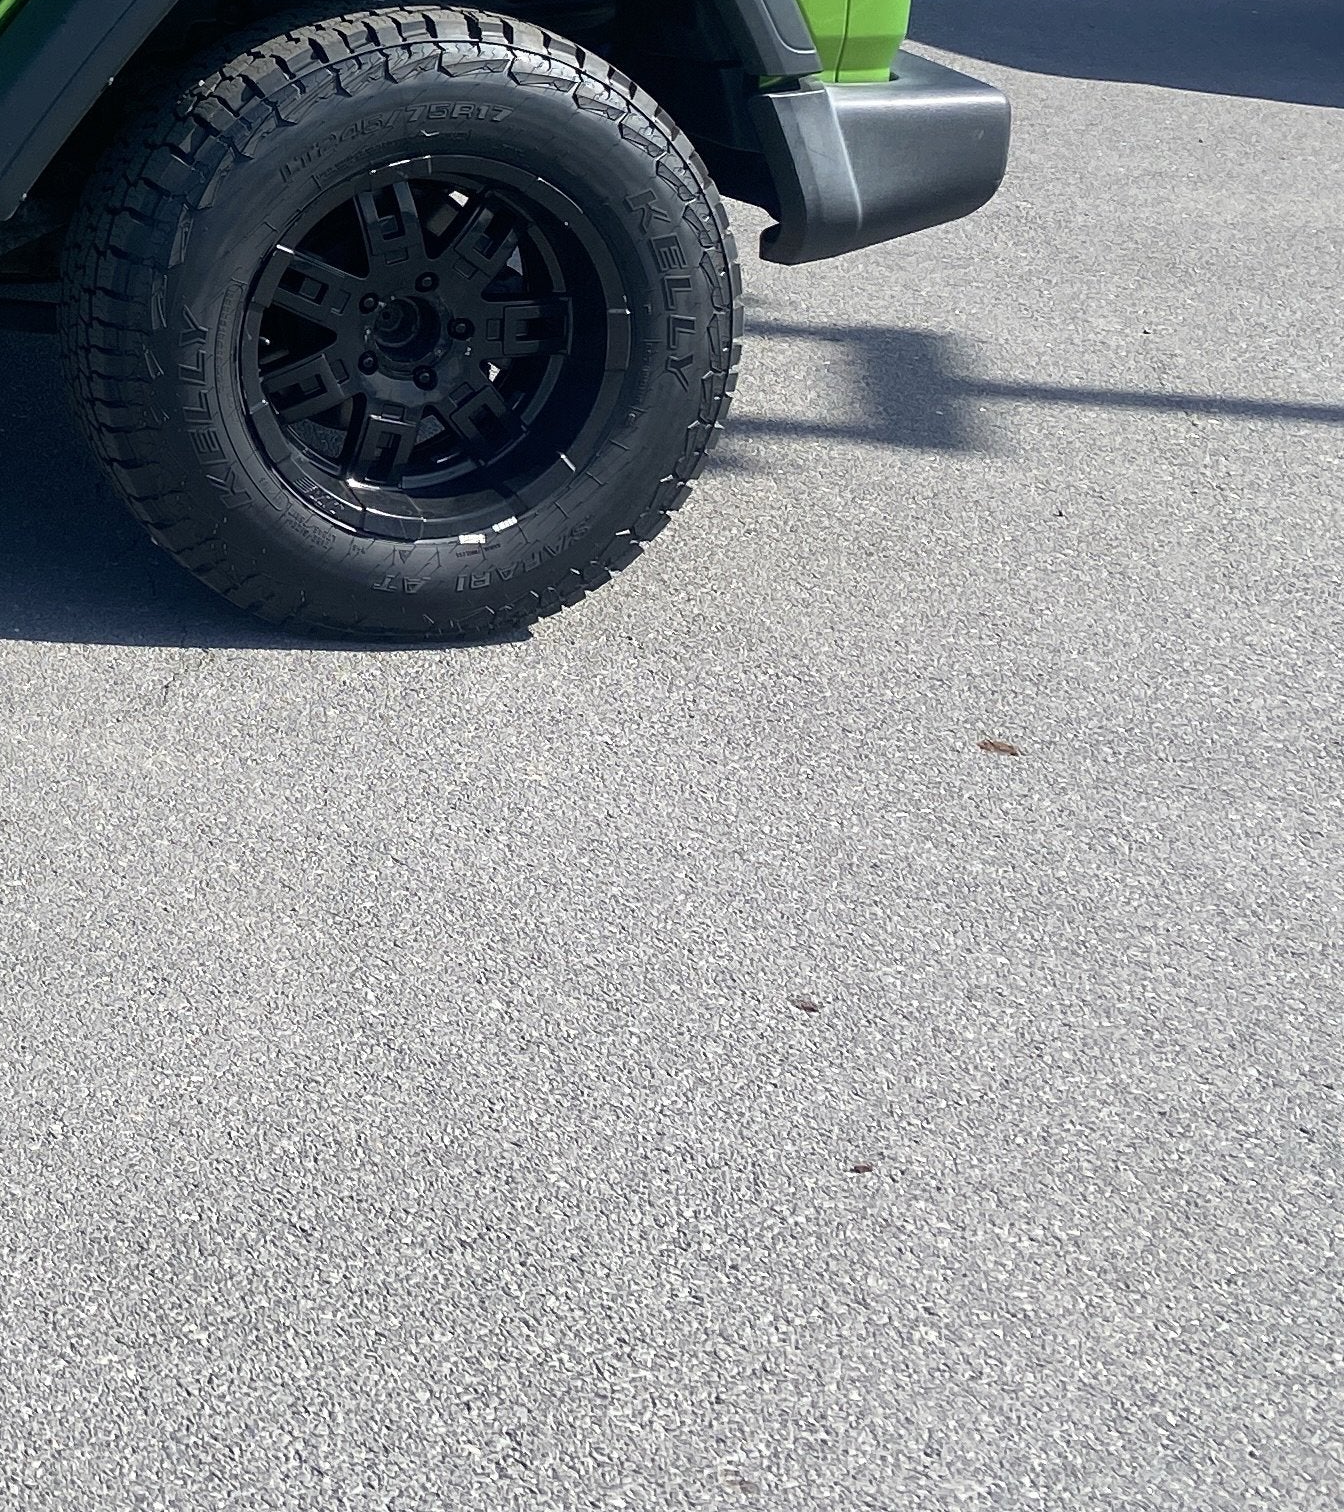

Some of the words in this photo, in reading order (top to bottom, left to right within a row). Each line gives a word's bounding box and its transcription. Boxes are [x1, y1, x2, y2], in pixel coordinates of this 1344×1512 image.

[623, 188, 697, 394] KELLY
[178, 304, 256, 510] KELLY
[372, 573, 433, 595] AT
[455, 519, 593, 593] SAFARI
